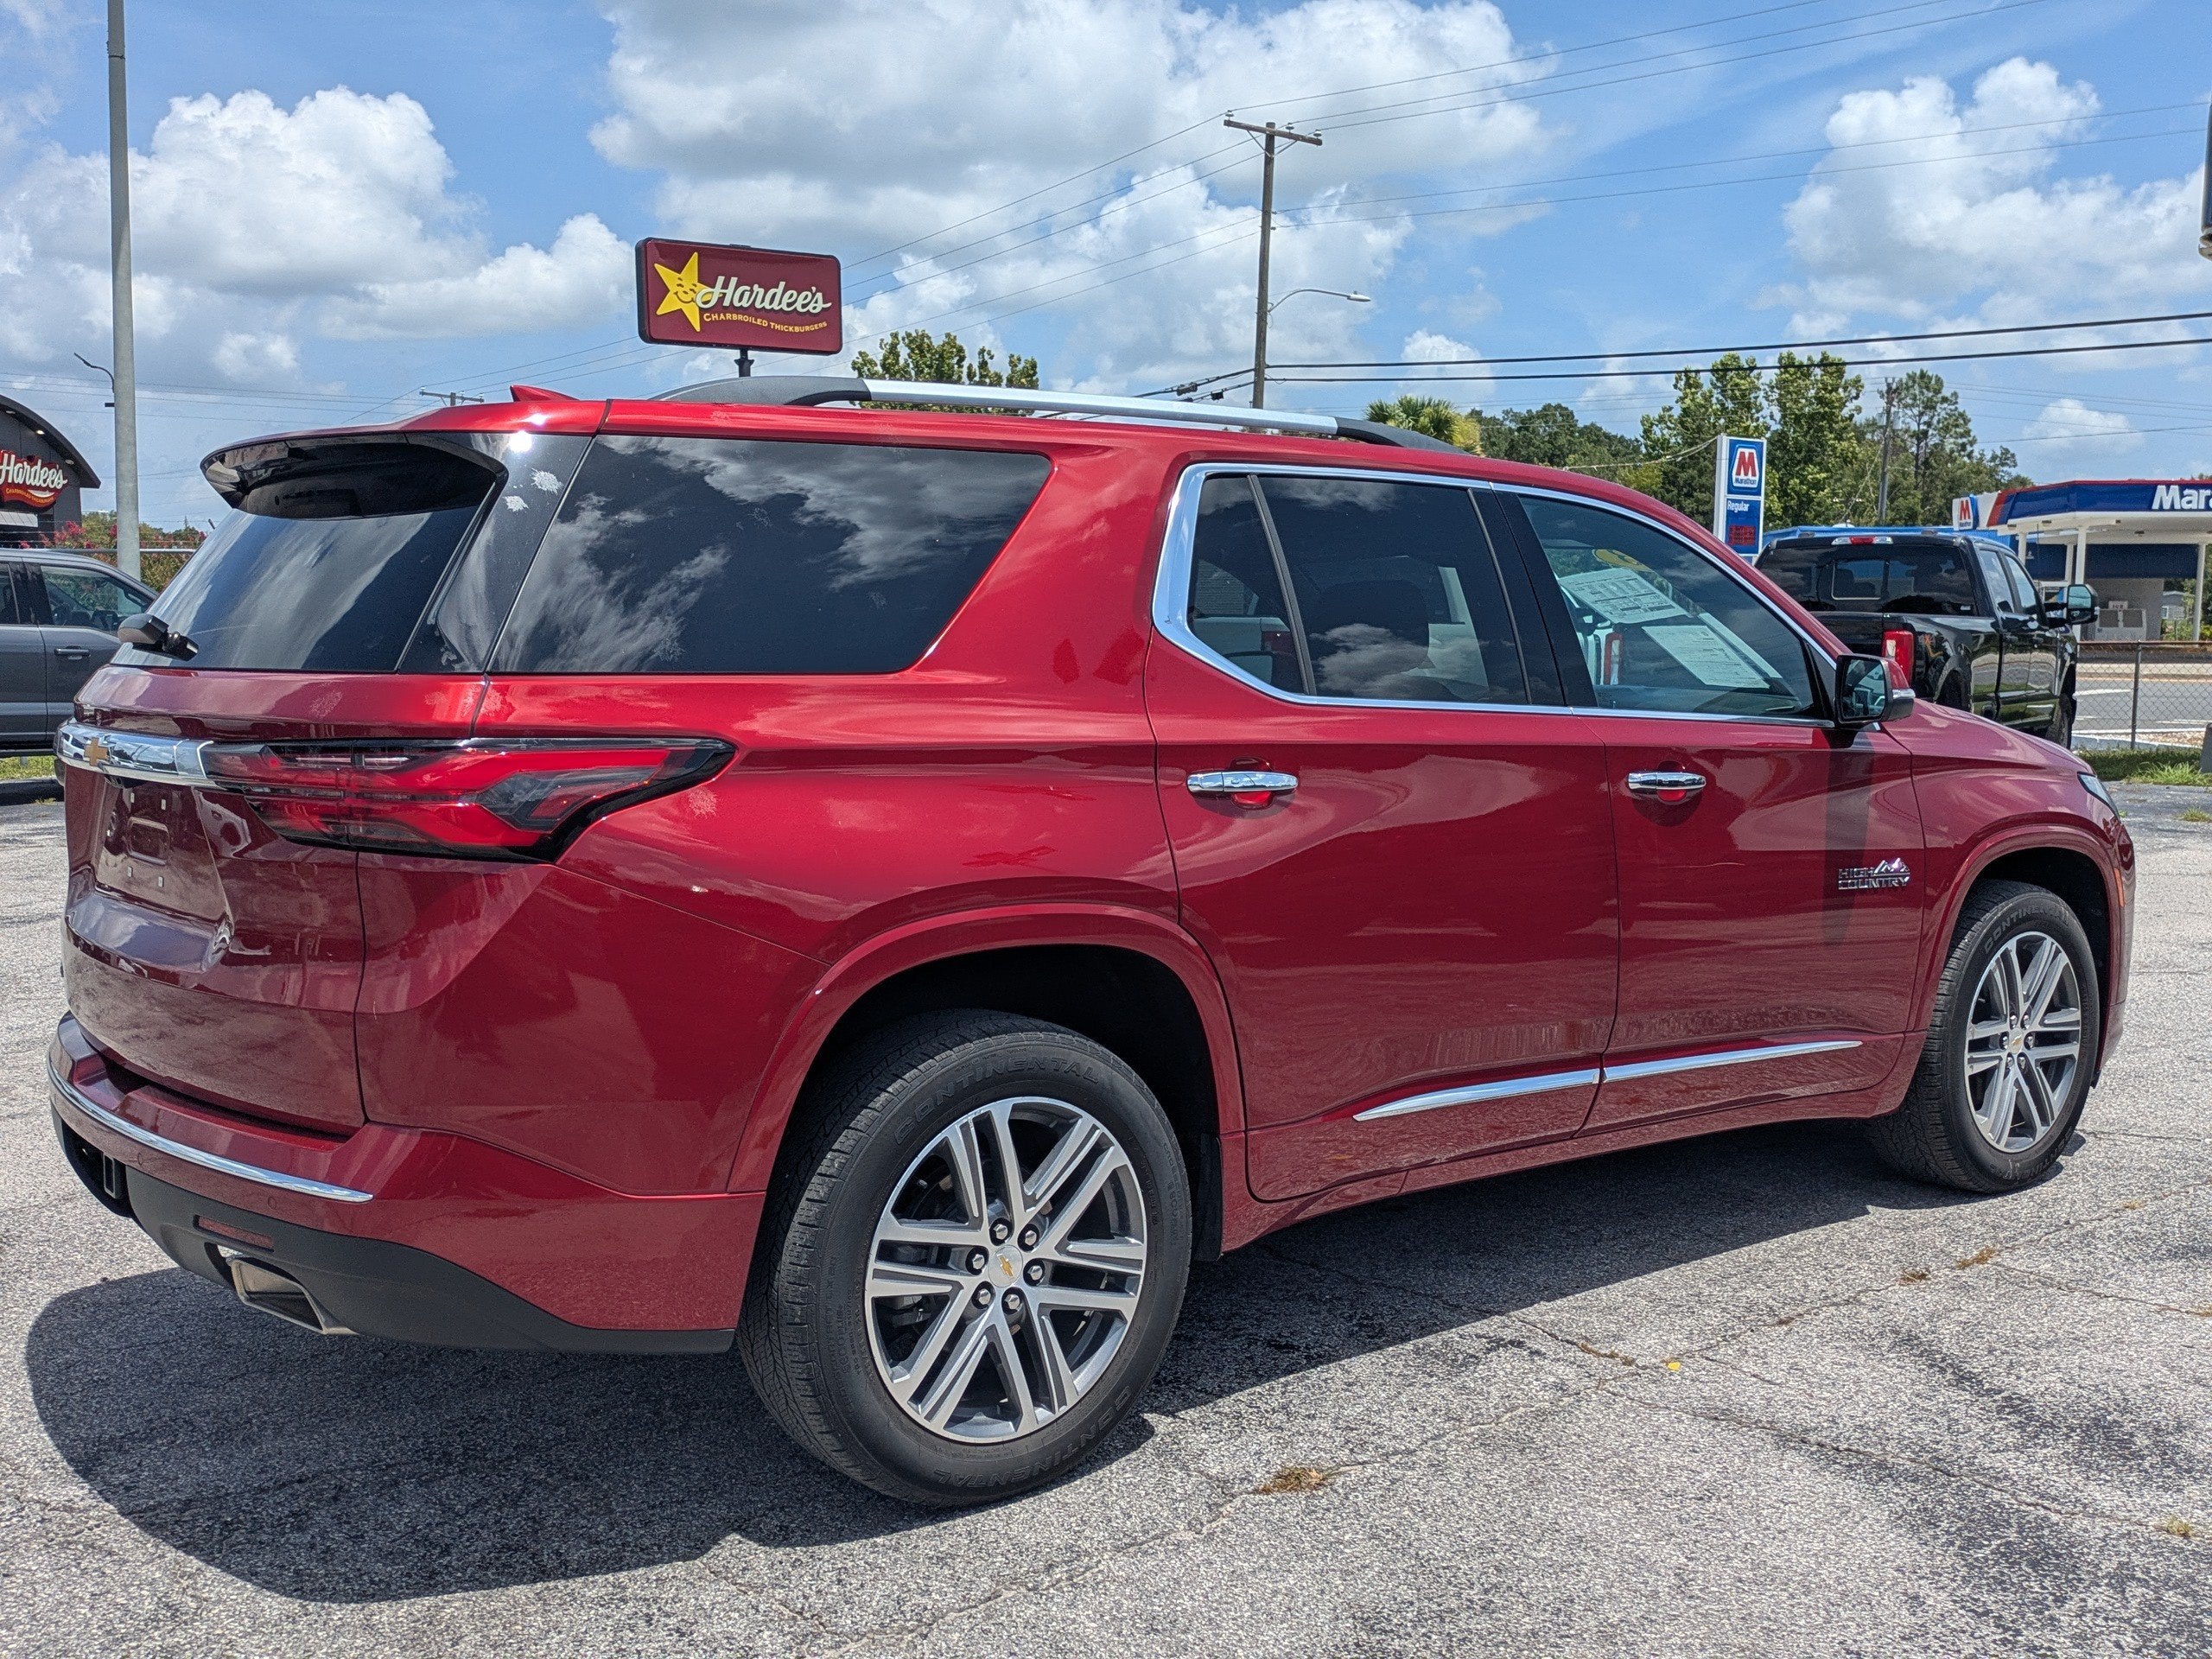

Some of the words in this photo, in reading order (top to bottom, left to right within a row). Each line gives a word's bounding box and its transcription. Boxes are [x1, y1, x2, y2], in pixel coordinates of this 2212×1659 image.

[696, 275, 832, 314] Hardee's
[703, 313, 768, 327] CHARBROILED
[769, 321, 828, 333] THICKBURGERS
[0, 453, 68, 489] Hardee's
[1727, 500, 1750, 512] Regular
[2152, 484, 2212, 510] Mar
[1838, 868, 1876, 879] HIGH
[1838, 876, 1910, 891] COUNTRY
[893, 1055, 1100, 1145] CONTINENTAL
[932, 1384, 1132, 1489] CONTINENTAL
